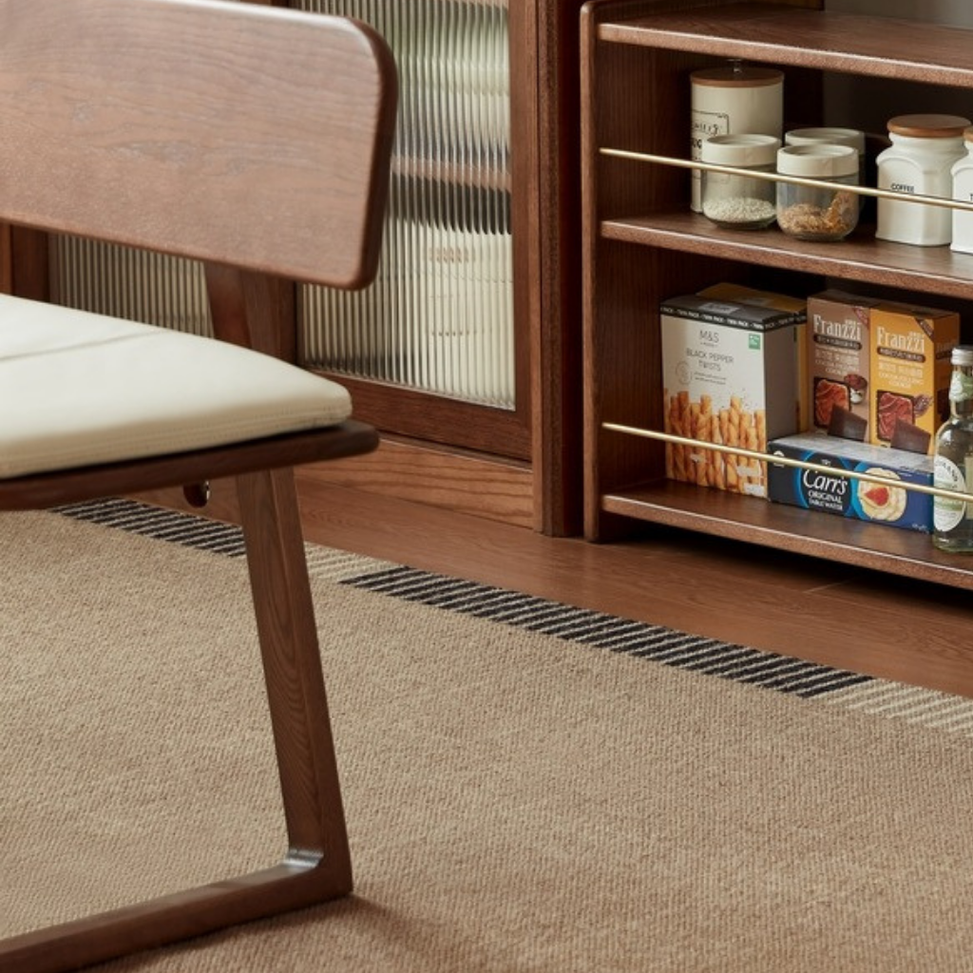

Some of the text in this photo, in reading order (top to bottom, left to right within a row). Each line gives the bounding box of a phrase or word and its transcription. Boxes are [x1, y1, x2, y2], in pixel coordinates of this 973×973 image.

[890, 183, 915, 193] COFFEE
[813, 314, 862, 340] Franzzi
[699, 330, 720, 343] M&S
[877, 326, 925, 354] Franzzi
[709, 352, 734, 364] PEPPER
[803, 468, 848, 495] Carr's
[808, 490, 842, 504] ORIGINAL
